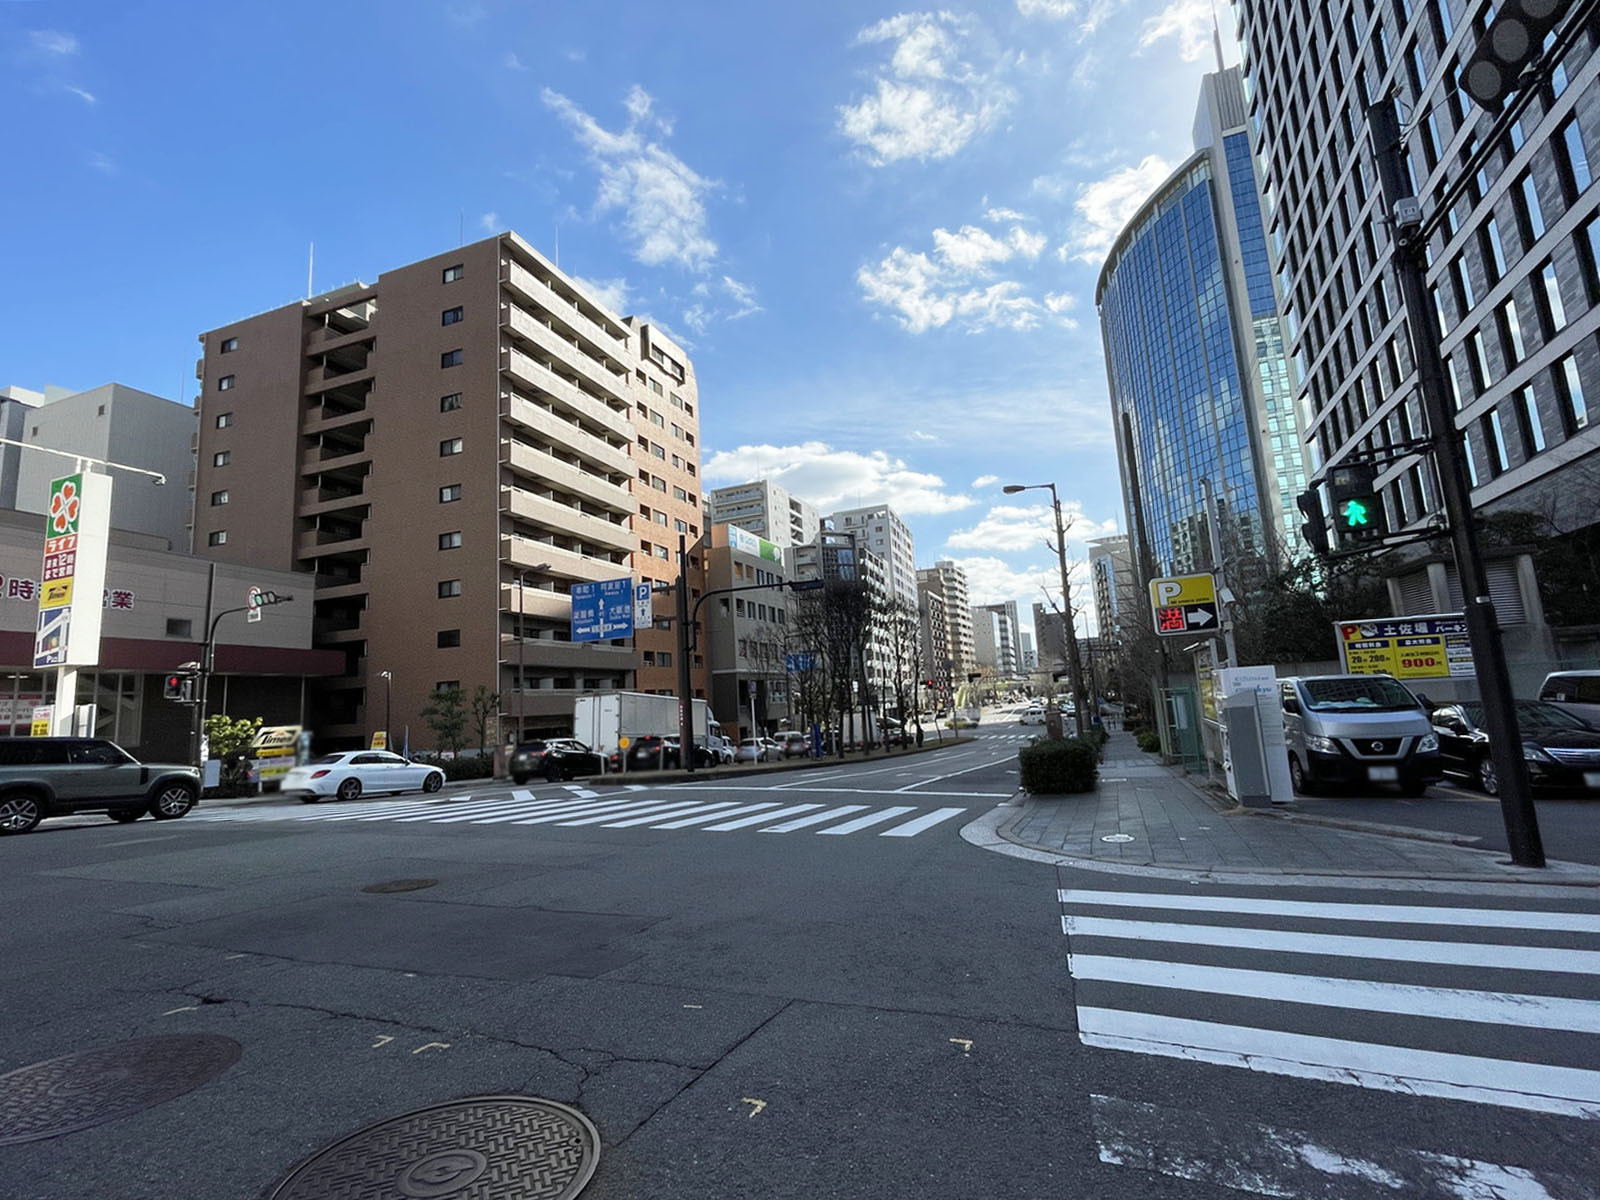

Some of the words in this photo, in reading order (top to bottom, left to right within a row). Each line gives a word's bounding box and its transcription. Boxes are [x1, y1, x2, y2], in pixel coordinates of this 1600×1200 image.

[48, 537, 76, 552] ライフ
[639, 587, 647, 599] P
[1157, 582, 1182, 606] P
[1159, 607, 1184, 630] 満
[1340, 625, 1358, 640] P
[1383, 622, 1429, 636] 土佐堀
